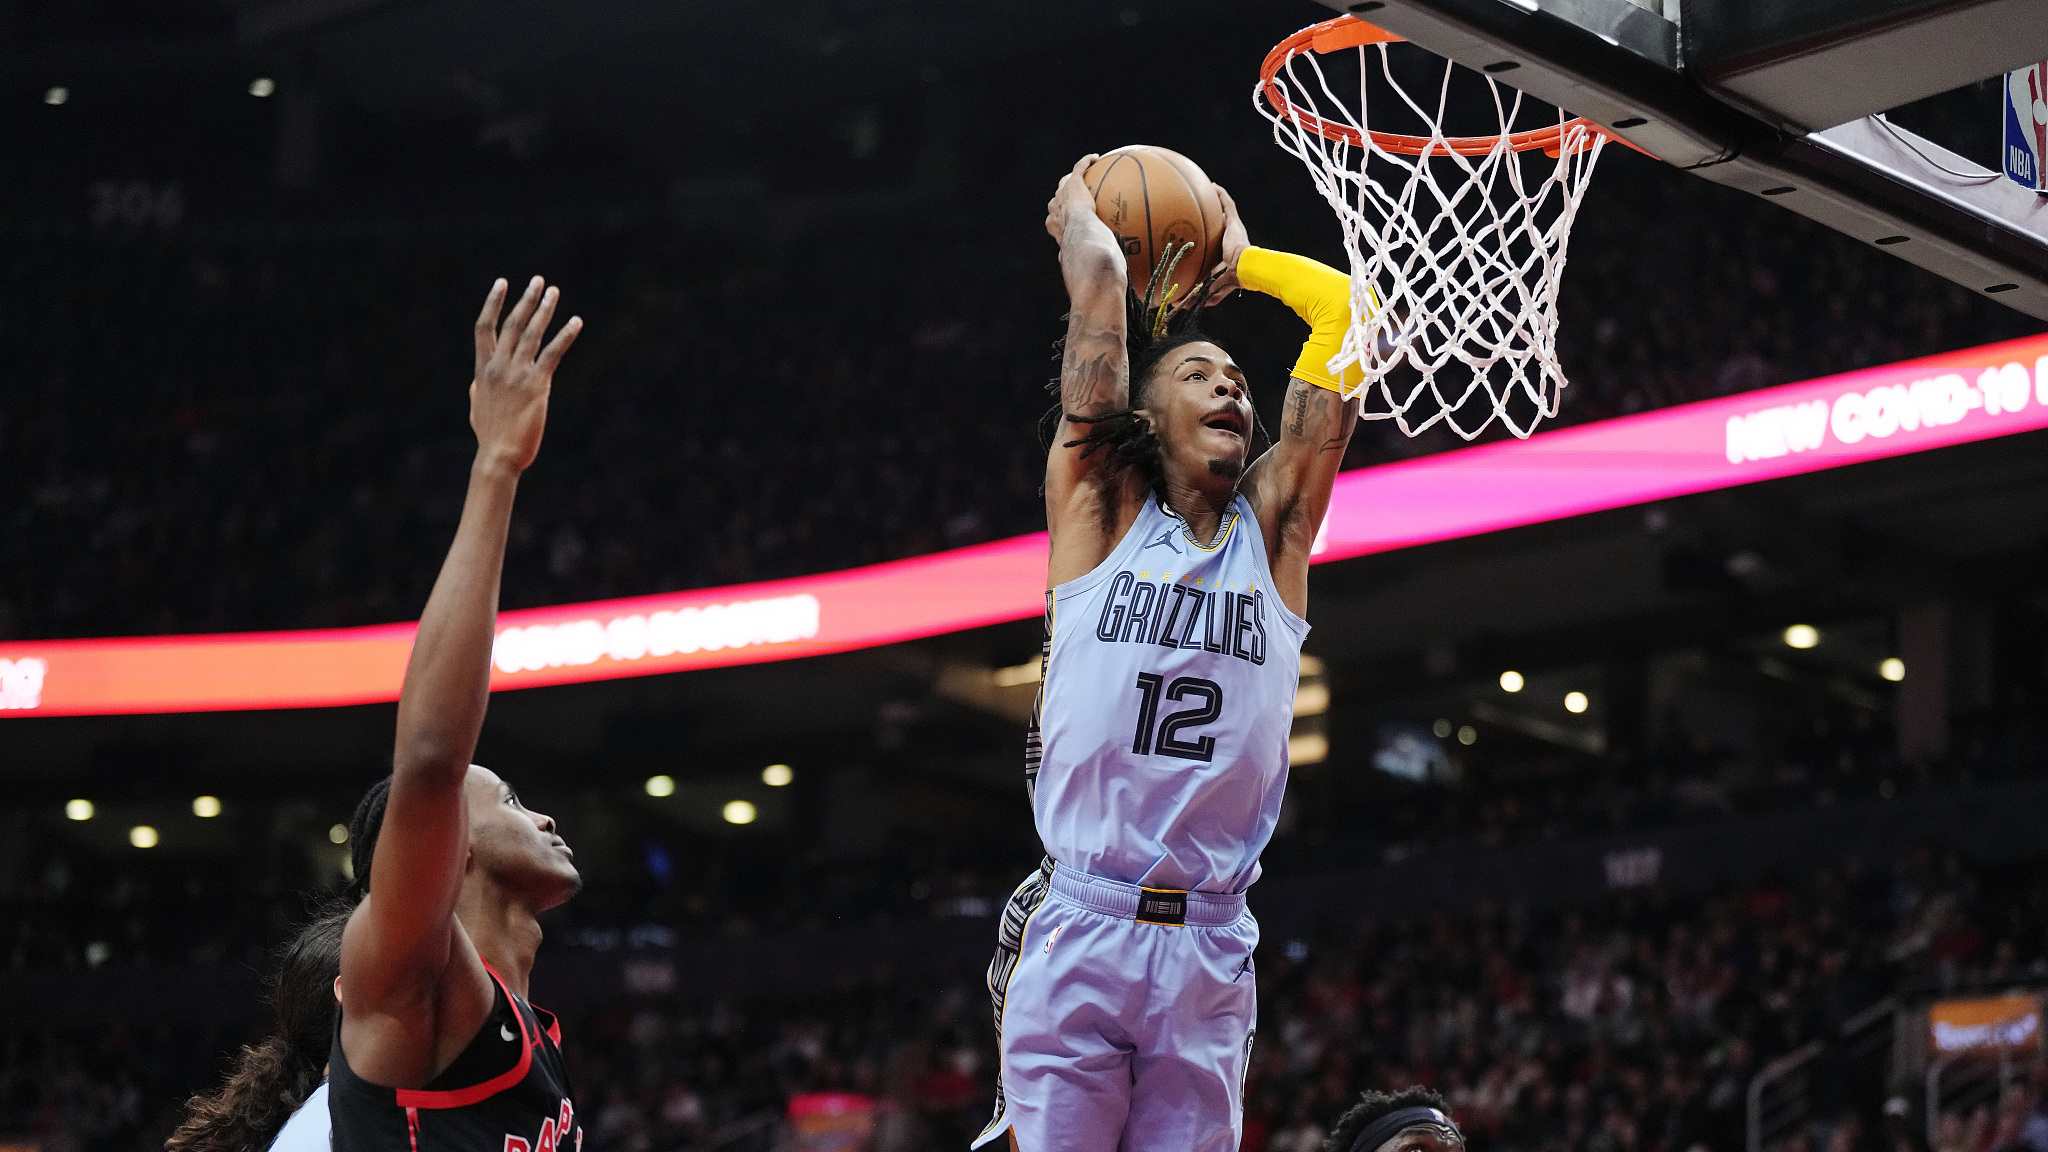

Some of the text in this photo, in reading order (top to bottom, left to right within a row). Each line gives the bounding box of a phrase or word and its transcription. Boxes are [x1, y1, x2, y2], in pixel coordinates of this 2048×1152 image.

[2009, 144, 2032, 181] NBA
[1726, 399, 1829, 464] NEW
[1096, 570, 1267, 666] GRIZZLIES
[1132, 671, 1223, 763] 12
[504, 1097, 583, 1152] RAP
